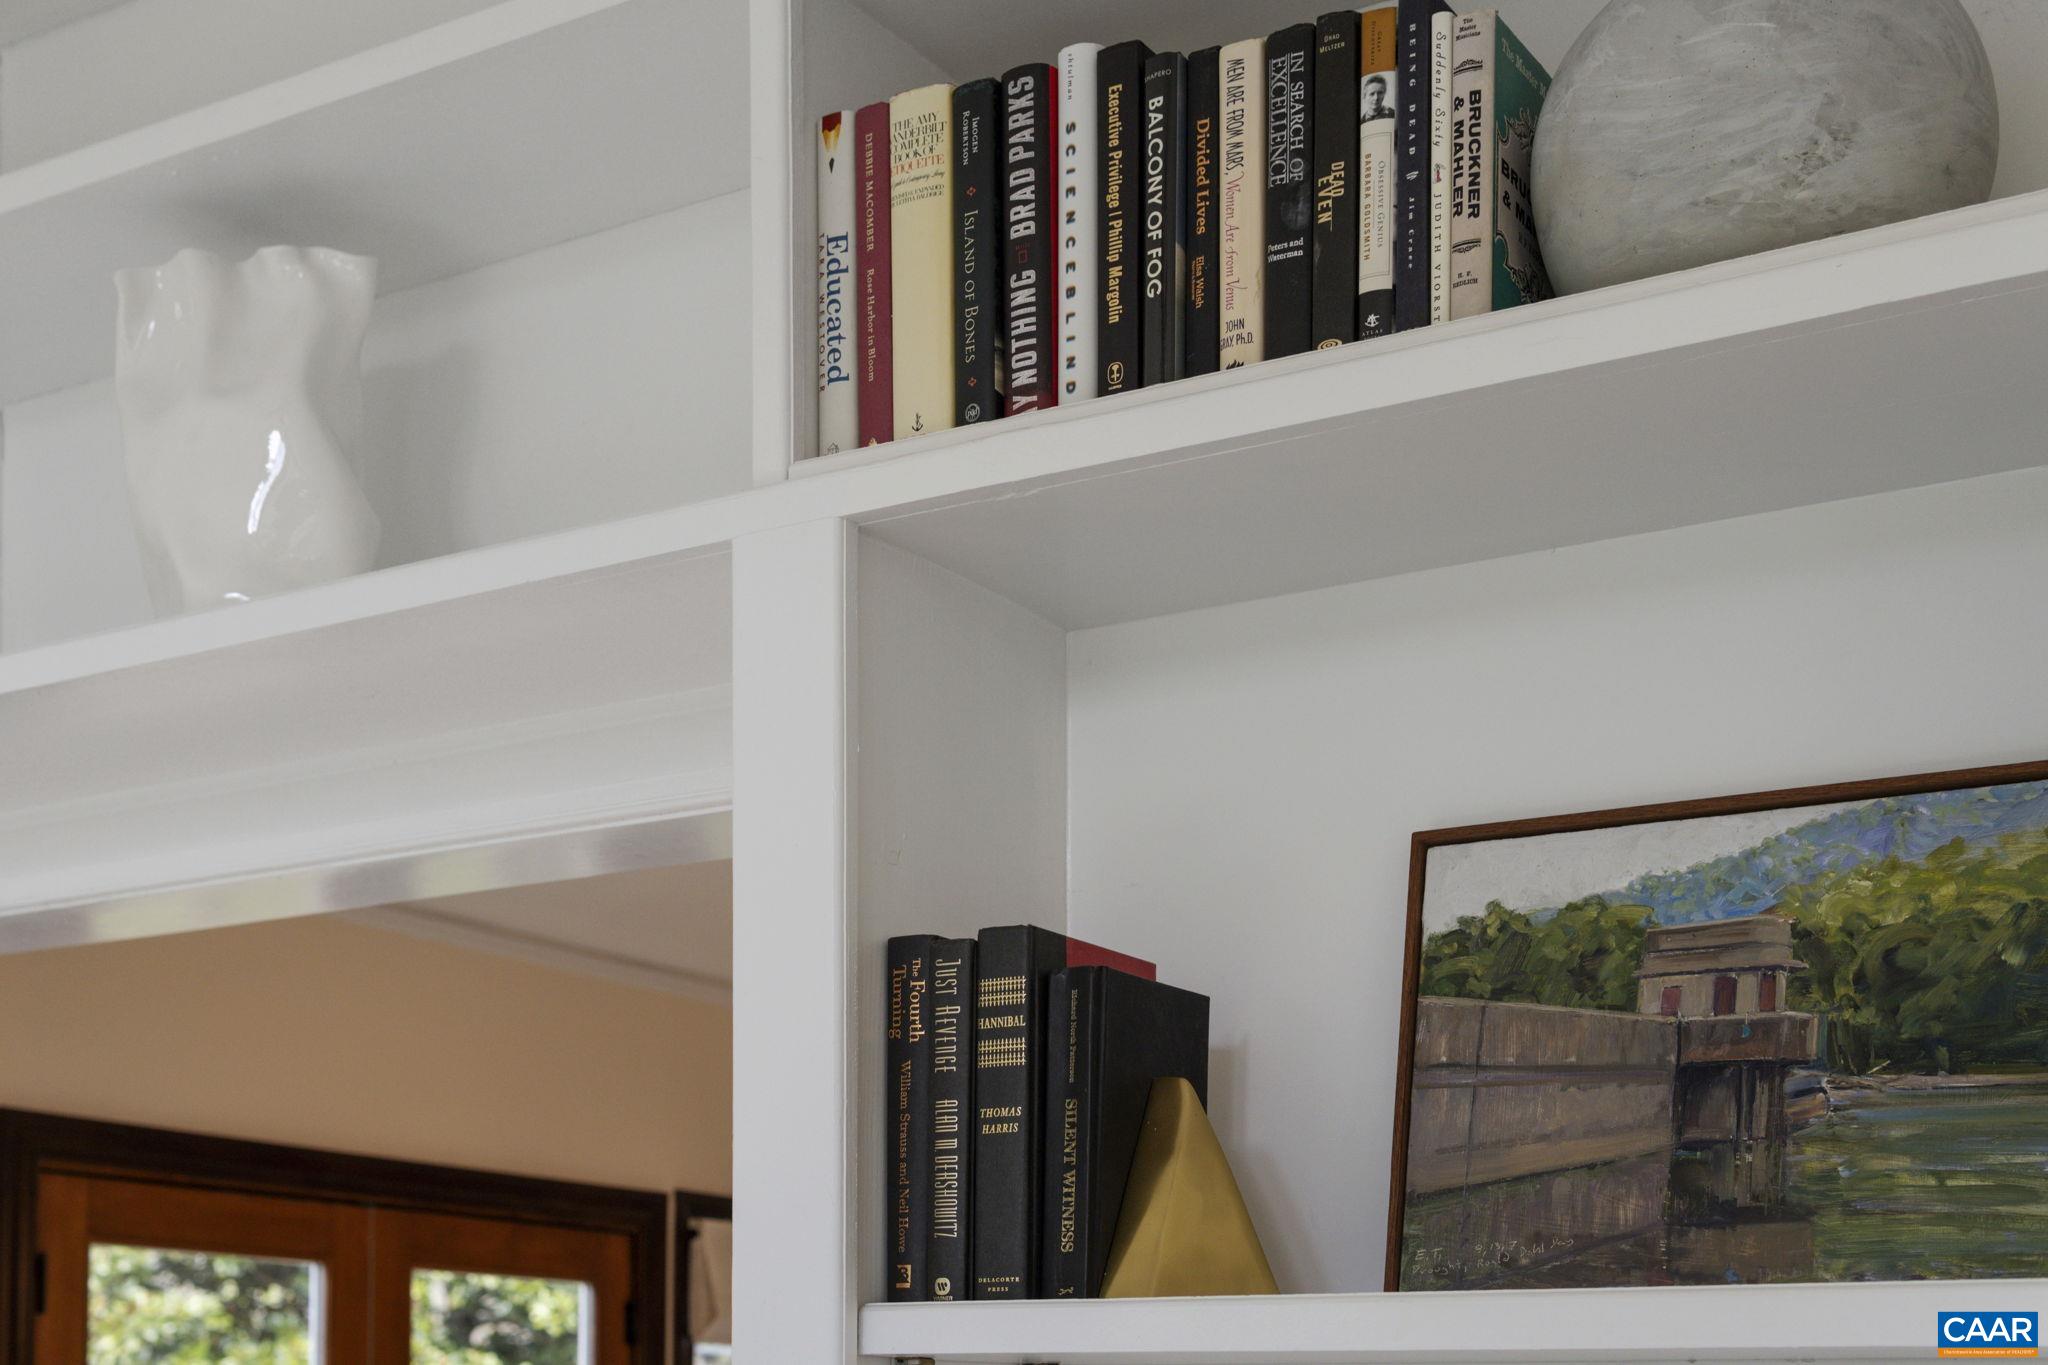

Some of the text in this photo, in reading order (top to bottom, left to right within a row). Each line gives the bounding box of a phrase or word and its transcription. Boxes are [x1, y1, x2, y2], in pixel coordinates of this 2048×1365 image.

[917, 112, 937, 125] AMY
[1007, 74, 1035, 149] PARKS
[1225, 58, 1245, 176] MEN ARE FROM MARS,
[1269, 56, 1288, 189] EXCELLENCE
[1289, 50, 1304, 182] IN SEARCH OF
[1408, 22, 1417, 157] BEING DEAD
[1432, 31, 1447, 148] Suddenly Sixty
[962, 110, 970, 166] ROBERTSON
[971, 116, 980, 153] IMOGEN
[1195, 117, 1211, 236] Divided Lives
[1453, 96, 1465, 219] & MAHLER
[1468, 89, 1482, 220] BRUCKNER
[864, 132, 875, 252] DEBBIE MACOMBER
[1009, 190, 1036, 241] BRAD
[1105, 83, 1123, 325] Executive Privilege Phillip Margolin
[1146, 95, 1164, 299] BALCONY OF FOG
[1317, 174, 1332, 225] EVEN
[1331, 161, 1345, 197] DEAD
[1363, 153, 1372, 261] BARBARA GOLDSMITH
[1377, 160, 1386, 248] OBSESSIVE GENIUS
[1224, 171, 1248, 311] Women Are from Venus
[1267, 237, 1304, 253] Peters and
[1267, 250, 1304, 263] Waterman
[1433, 193, 1443, 323] JUDITH VIORST
[826, 231, 850, 385] Educated
[866, 268, 876, 382] Rose Harbor in Bloom
[964, 208, 980, 366] ISLAND OF BONES
[1010, 268, 1038, 389] NOTHING
[1195, 275, 1205, 310] Walsh
[1225, 318, 1245, 333] JOHN
[818, 295, 826, 392] WESTOVER
[1235, 332, 1254, 345] Ph.D.
[888, 965, 906, 1040] Turning
[909, 957, 926, 1044] The Fourth
[934, 957, 962, 1074] JUST REVENGE
[977, 1014, 1026, 1030] HANNIBAL
[900, 1060, 911, 1110] William
[934, 1098, 958, 1133] ALAN
[979, 1106, 1022, 1119] THOMAS
[899, 1112, 911, 1158] Strauss
[981, 1122, 1019, 1135] HARRIS
[899, 1160, 909, 1185] and
[899, 1187, 910, 1215] Neil
[933, 1154, 958, 1239] DERSHOWITZ
[1060, 1097, 1078, 1253] SILENT WITNESS
[898, 1216, 910, 1253] Howe
[977, 1276, 1020, 1284] DELACORTE
